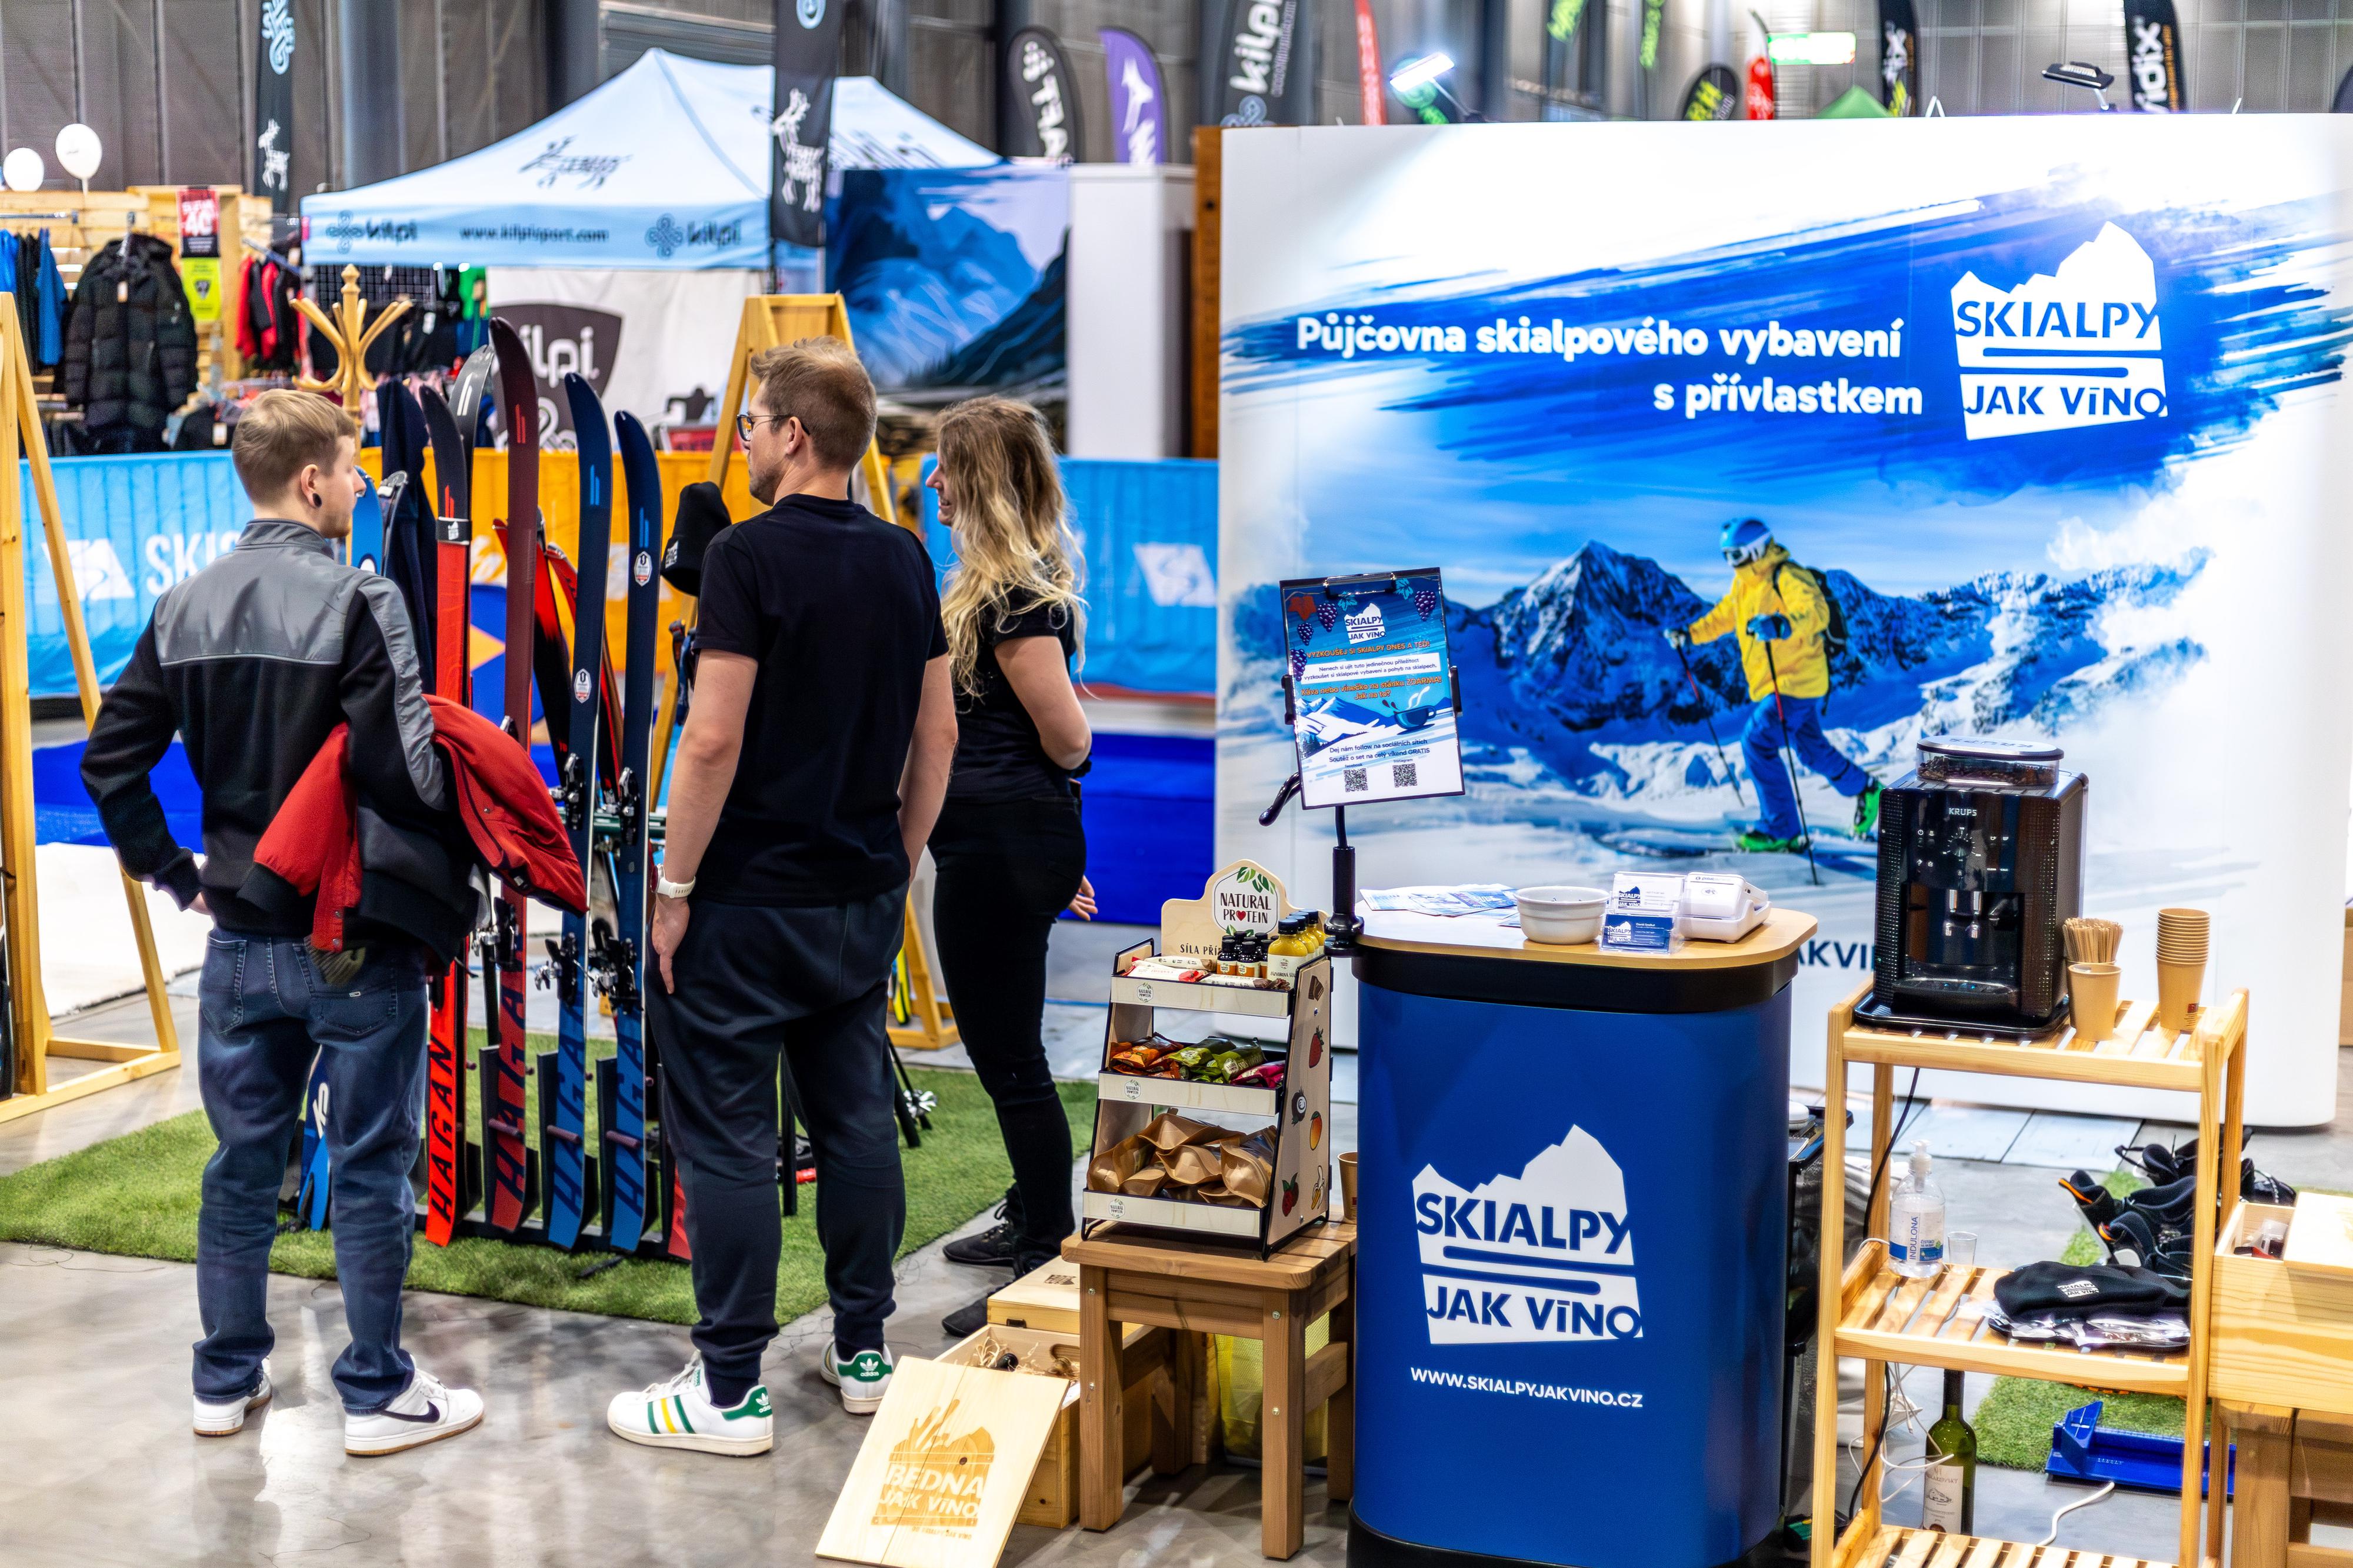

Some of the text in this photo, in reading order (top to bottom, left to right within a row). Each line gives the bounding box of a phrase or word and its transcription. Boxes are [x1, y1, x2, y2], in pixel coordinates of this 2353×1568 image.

[1956, 301, 2157, 338] SKIALPY
[1298, 312, 1905, 365] Půjčovna skialpového vybavení
[1653, 372, 1923, 419] s přívlastkem
[1964, 386, 2045, 415] JAK
[1345, 616, 1382, 626] SKIALPY
[1307, 648, 1347, 658] VYZKOUŠEJ
[1358, 644, 1385, 653] SKIALPY
[1366, 659, 1394, 668] jedinečnou
[1304, 673, 1329, 681] vyzkoušet
[1380, 680, 1405, 688] stánku
[1406, 675, 1442, 686] ZDARMA!
[1354, 692, 1368, 700] Jak
[1949, 808, 1978, 816] KRUPS
[1220, 892, 1272, 910] NATURAL
[1180, 942, 1199, 955] SÍLA
[1798, 939, 1875, 970] KVI
[429, 1033, 454, 1224] HAGAN
[1417, 1192, 1631, 1255] SKIALPY
[1909, 1216, 1919, 1260] INDULONA
[1427, 1286, 1512, 1327] JAK
[1411, 1367, 1644, 1408] WWW.SKIALPYJAKVINO.CZ
[885, 1463, 985, 1499] BEDNA
[879, 1489, 922, 1510] JAK
